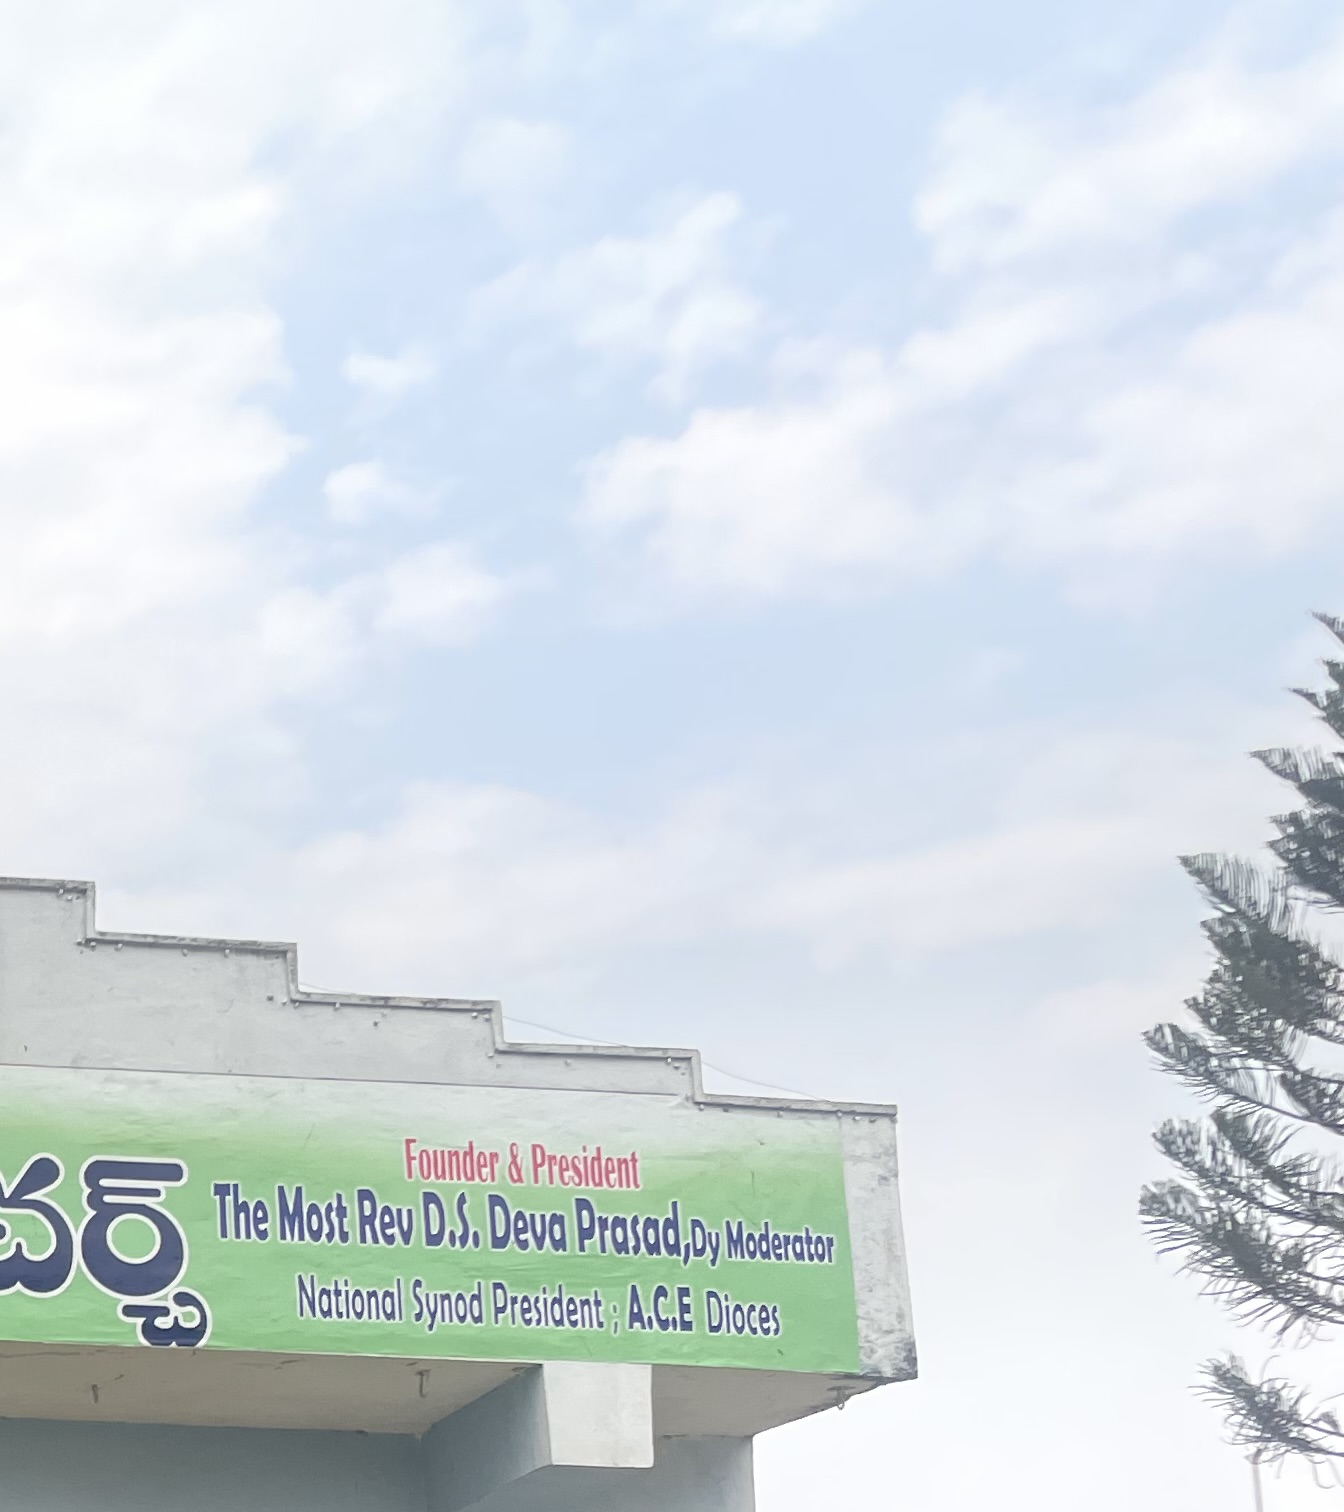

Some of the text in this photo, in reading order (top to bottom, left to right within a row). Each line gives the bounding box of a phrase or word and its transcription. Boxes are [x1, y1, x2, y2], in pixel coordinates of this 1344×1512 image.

[404, 1138, 641, 1189] Founder & President
[213, 1182, 269, 1241] The
[277, 1185, 349, 1244] Most
[357, 1188, 413, 1246] Rev
[422, 1191, 480, 1249] D.S.
[488, 1193, 567, 1252] Deva
[725, 1218, 835, 1264] Moderator
[297, 1273, 403, 1322] National
[412, 1278, 483, 1332] Synod
[492, 1281, 605, 1329] President
[628, 1284, 694, 1332] A.C.E
[706, 1290, 781, 1337] Dioces
